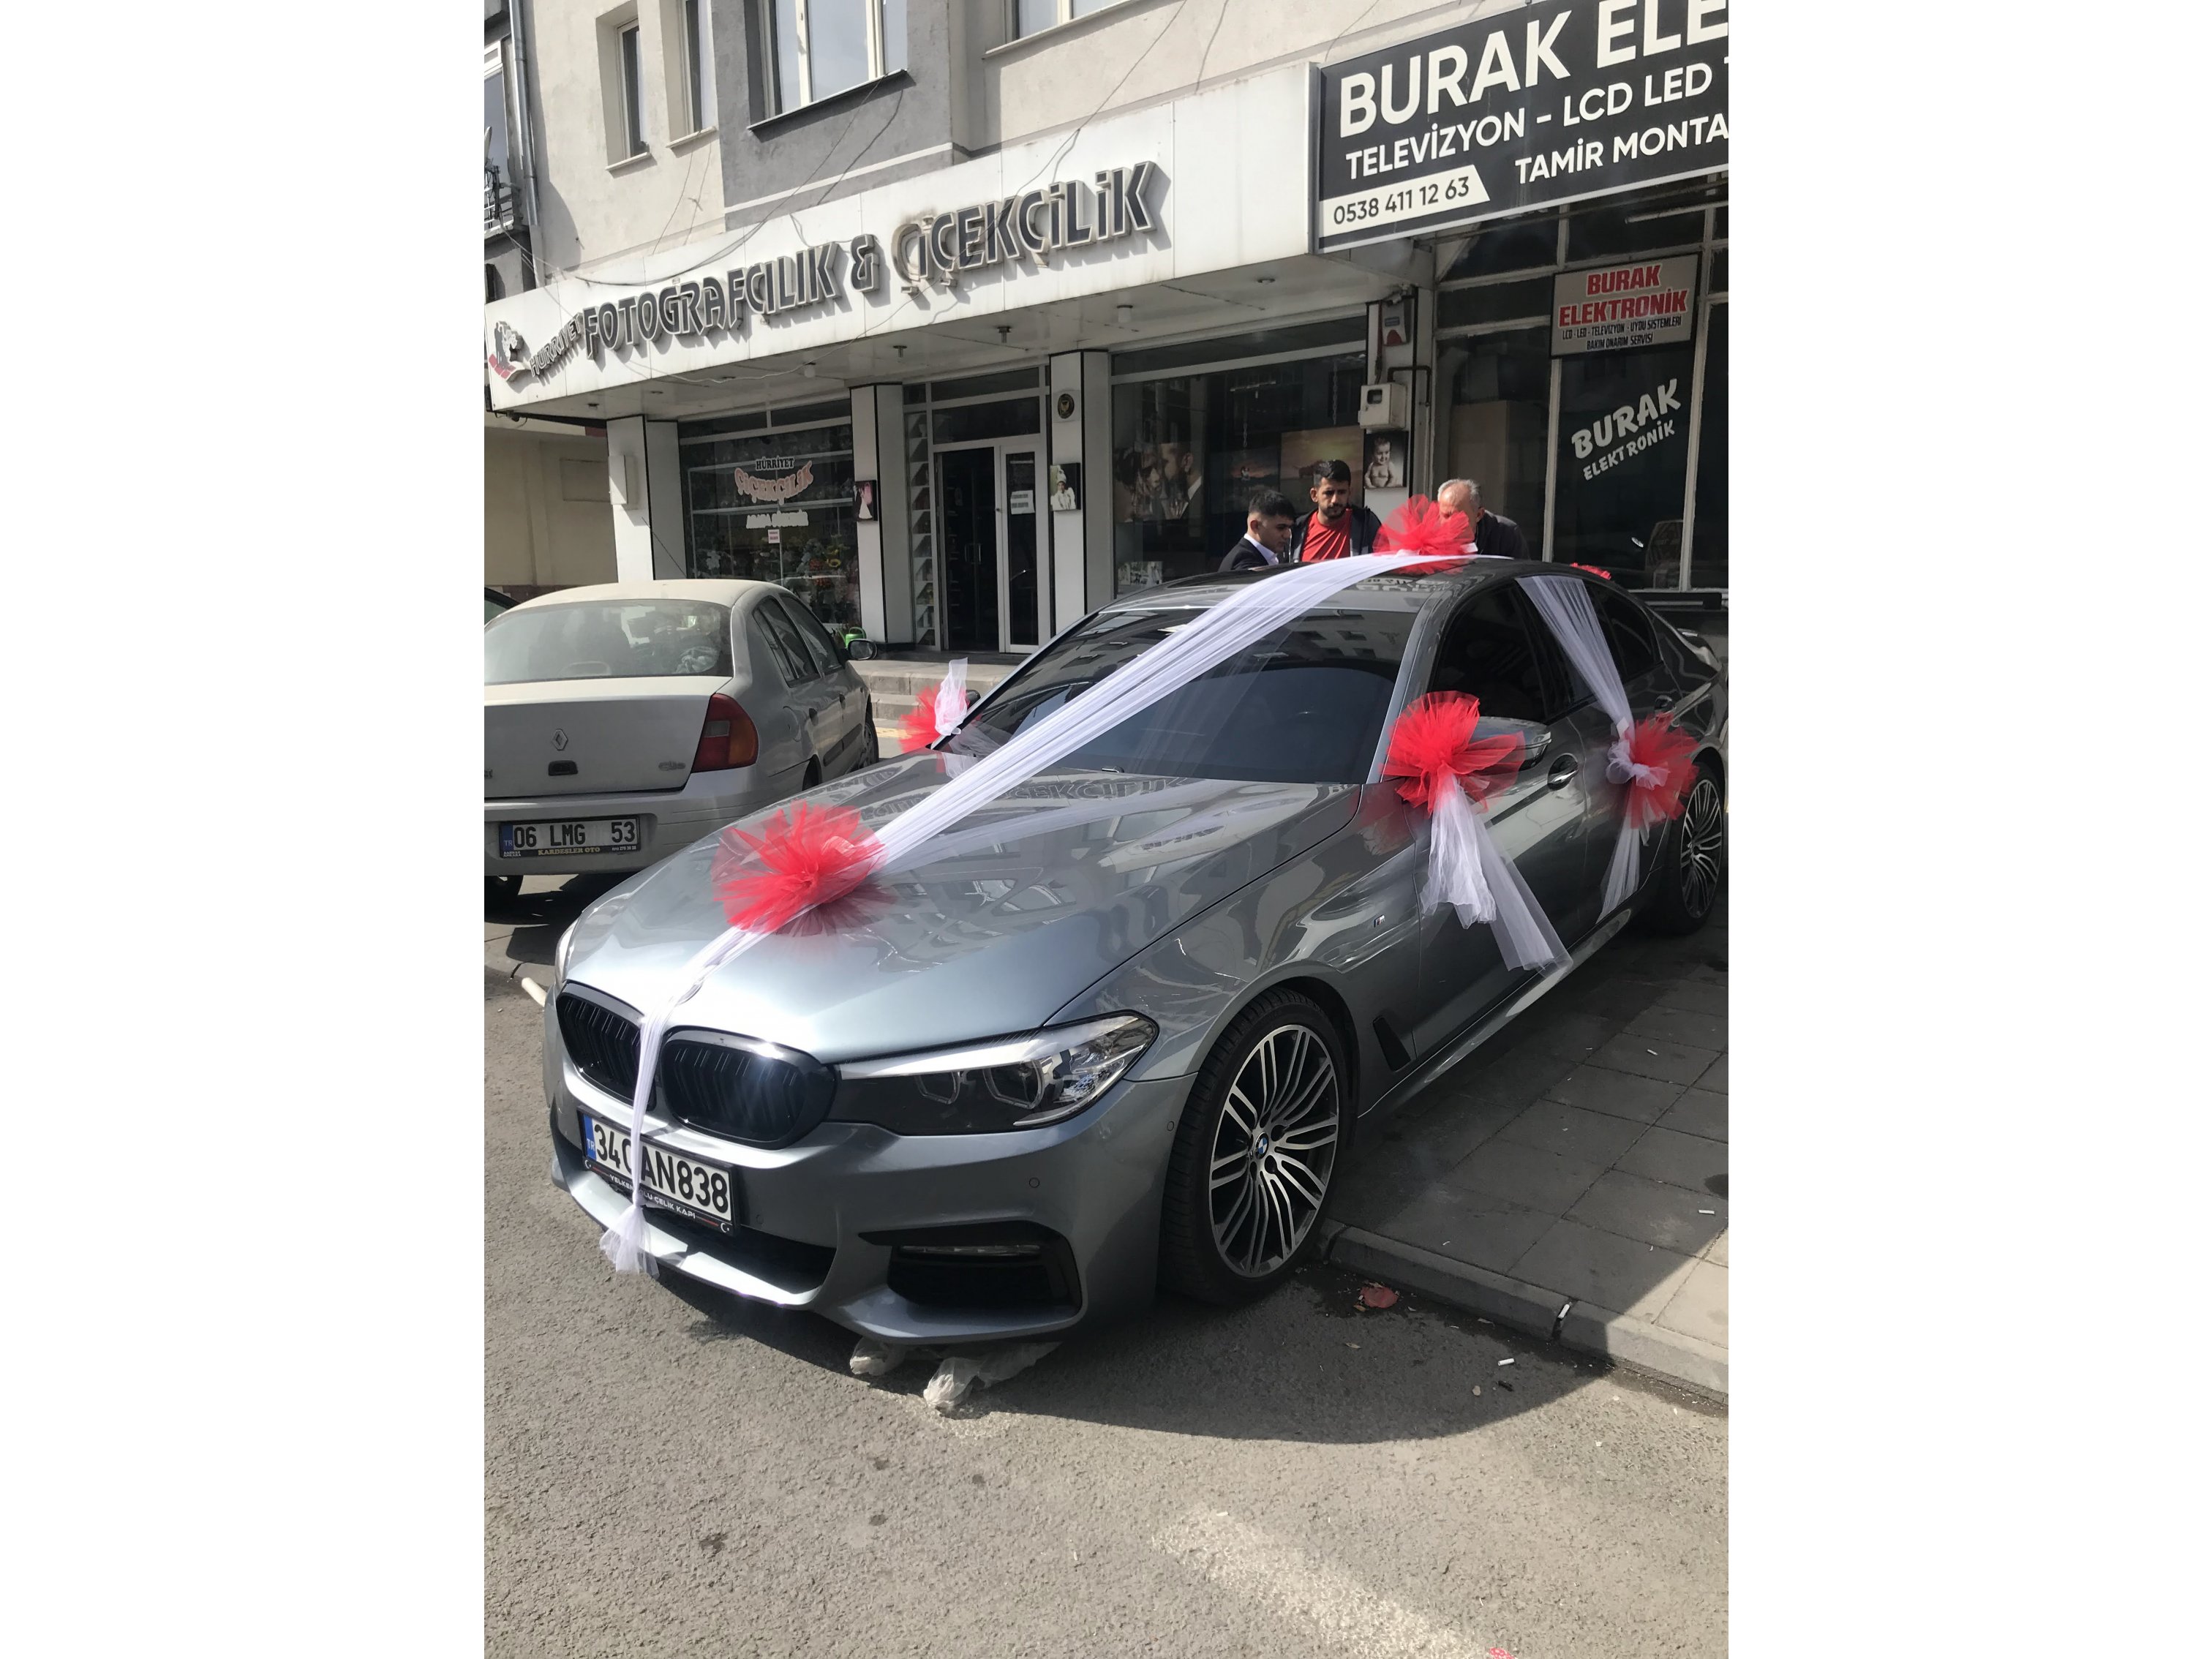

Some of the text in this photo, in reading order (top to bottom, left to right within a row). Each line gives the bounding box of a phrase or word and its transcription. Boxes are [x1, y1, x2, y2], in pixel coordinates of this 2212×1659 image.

[1340, 0, 1728, 138] BURAK ELE
[1346, 108, 1526, 179] TELEVİZYON
[1564, 81, 1633, 127] LCD
[1645, 63, 1712, 106] LED
[1515, 113, 1728, 184] TAMİR MONTA
[1333, 176, 1470, 225] 0538 411 12 63
[851, 234, 879, 292] &
[1587, 265, 1660, 296] BURAK
[1559, 289, 1688, 327] ELEKTRONİK
[1562, 329, 1573, 339] LCD
[1577, 328, 1587, 339] LED
[1587, 339, 1605, 350] BAKIM
[1606, 336, 1628, 349] ONARIM
[1571, 378, 1681, 459] BURAK
[756, 456, 794, 470] HÜRRİYET
[1582, 419, 1675, 481] ELEKTRONİK
[514, 821, 635, 848] 06 LMG 53
[587, 1139, 595, 1151] TR
[655, 1196, 674, 1211] ÇELİK
[677, 1206, 696, 1219] KAPI
